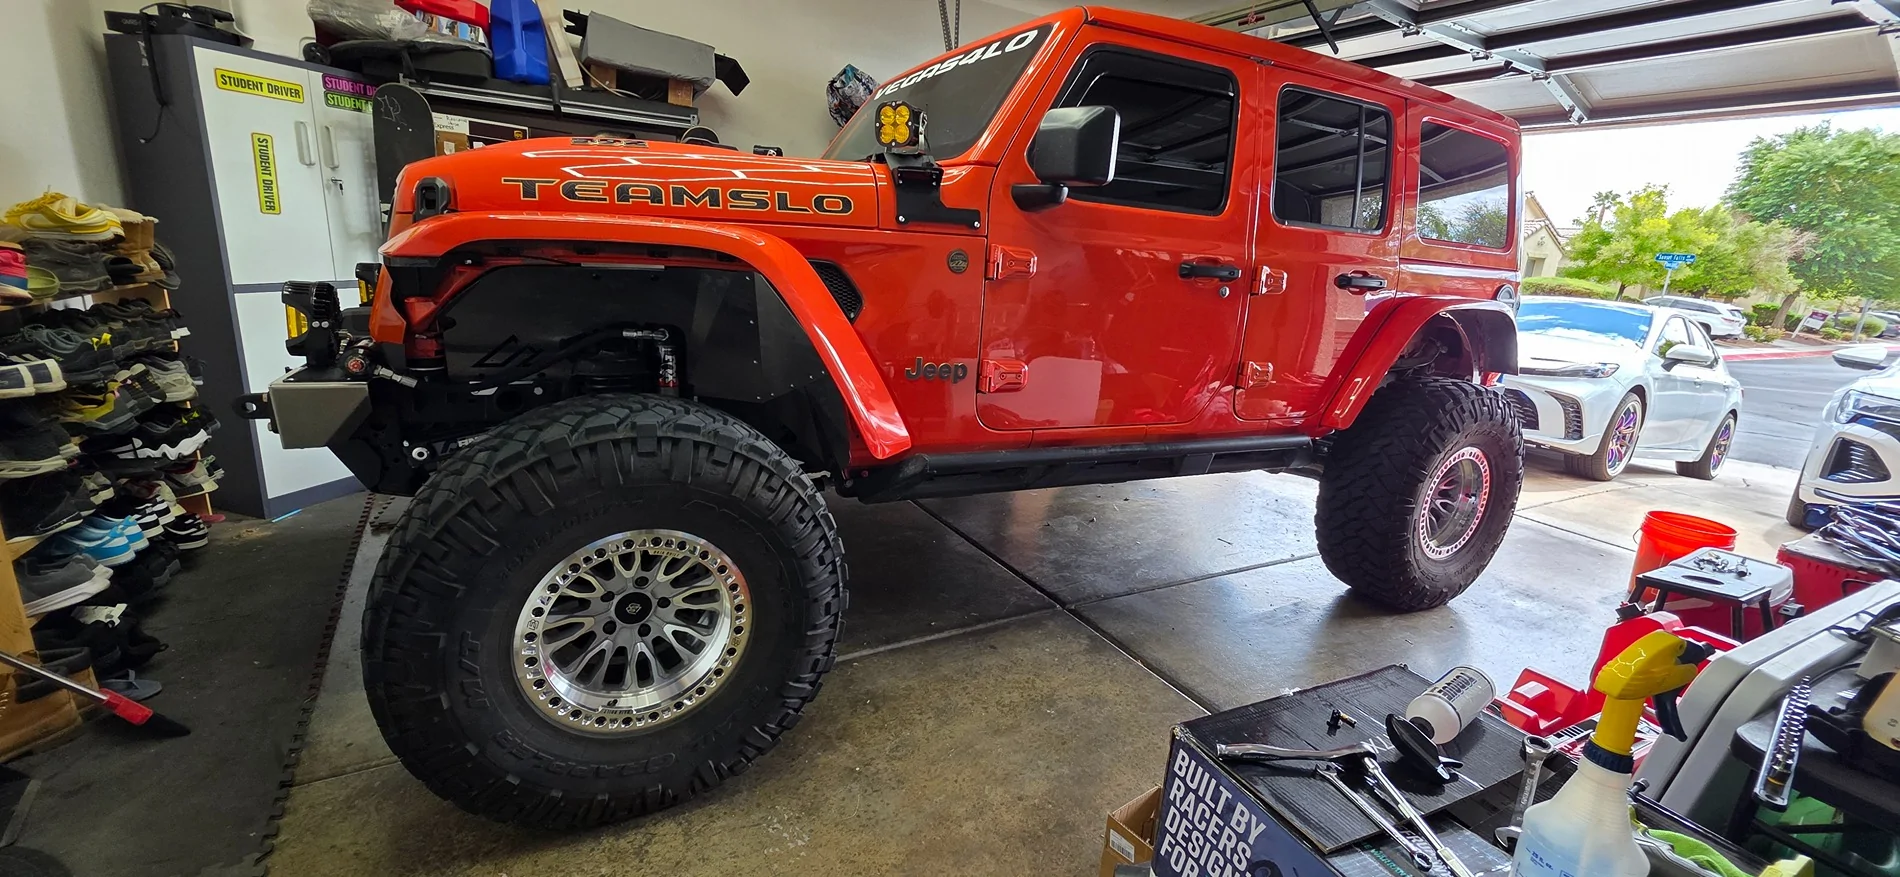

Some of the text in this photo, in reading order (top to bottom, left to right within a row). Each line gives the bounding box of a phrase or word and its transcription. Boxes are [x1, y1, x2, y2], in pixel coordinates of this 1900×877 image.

[325, 77, 365, 94] STUDENT
[874, 30, 1038, 101] VEGAS4LO
[220, 74, 301, 99] STUDENT DRIVER
[327, 94, 366, 111] STUDENT
[257, 137, 276, 211] STUDENT DRIVER
[502, 178, 854, 216] TEAMSLO
[905, 356, 968, 384] Jeep
[458, 630, 492, 708] M/T
[1437, 672, 1478, 703] TORQUE
[1173, 748, 1267, 846] BUILT BY
[1169, 777, 1251, 872] RACERS
[1160, 833, 1200, 877] FOR
